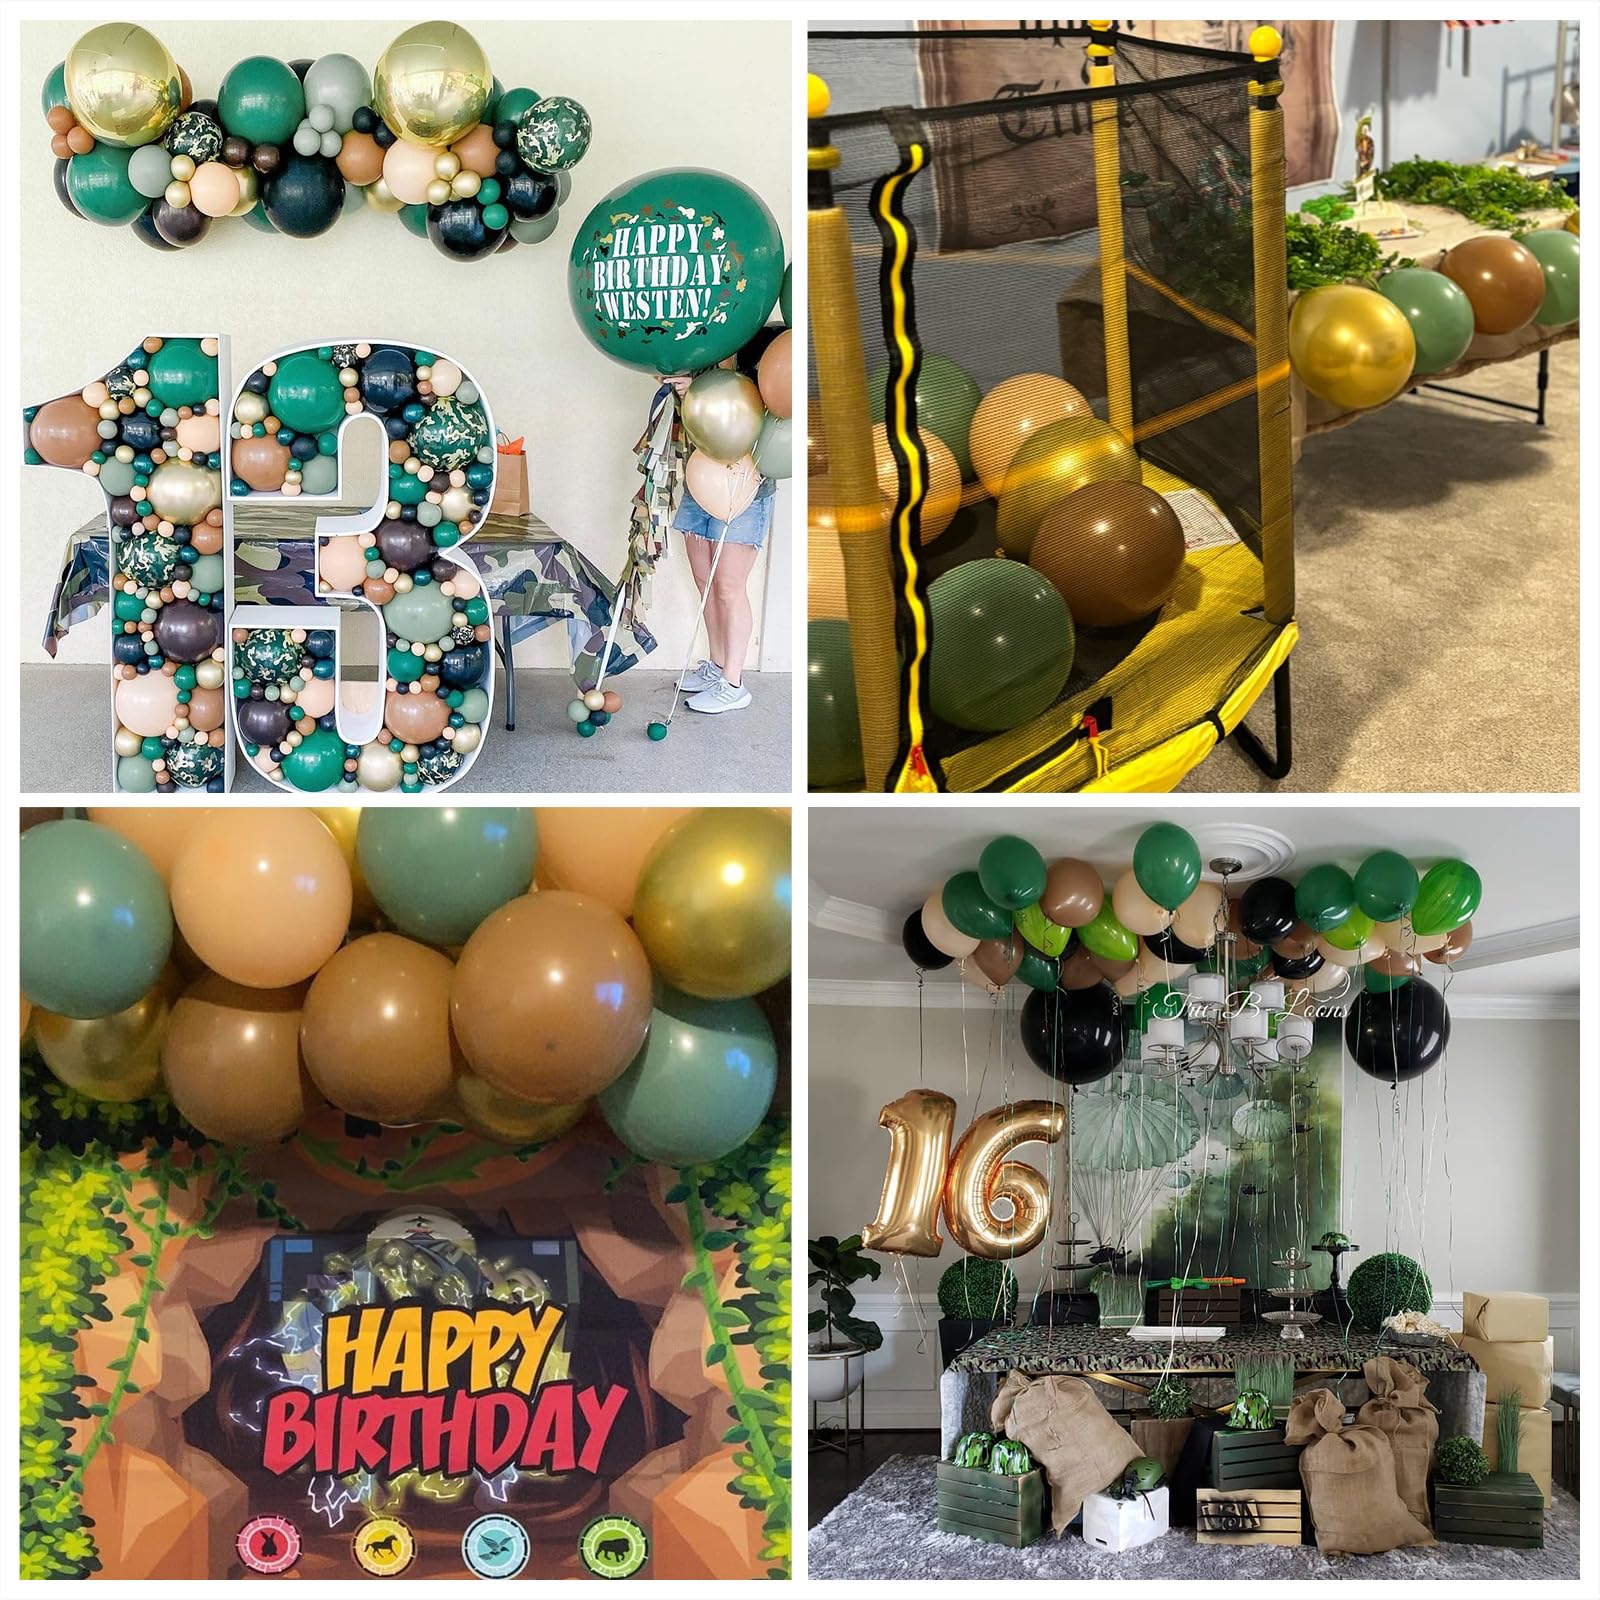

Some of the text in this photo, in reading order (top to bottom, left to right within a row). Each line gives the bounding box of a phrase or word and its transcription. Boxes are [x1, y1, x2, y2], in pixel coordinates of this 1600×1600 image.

[612, 223, 704, 258] HAPPY
[594, 254, 727, 292] BIRTHDAY
[603, 287, 712, 321] WESTEN!
[861, 1088, 1067, 1260] 16
[327, 1305, 565, 1396] HAPPY
[262, 1383, 629, 1477] BIRTHDAY
